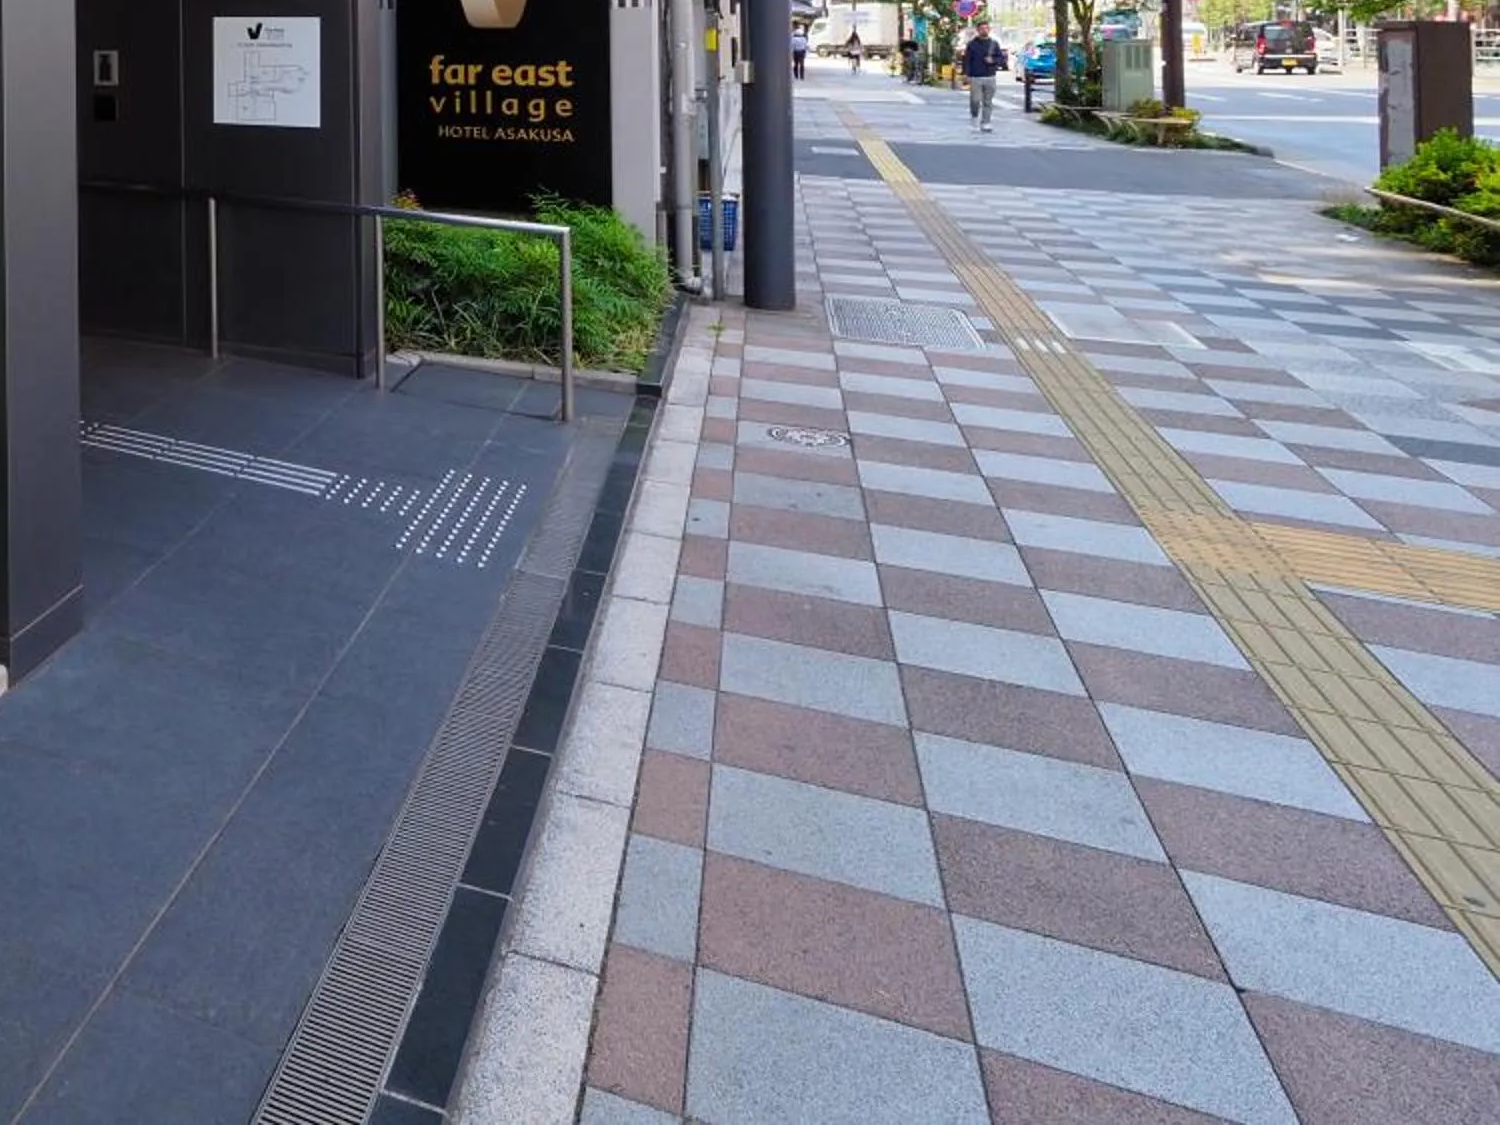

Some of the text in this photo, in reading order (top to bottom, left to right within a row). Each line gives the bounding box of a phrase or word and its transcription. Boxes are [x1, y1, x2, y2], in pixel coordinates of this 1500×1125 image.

[430, 56, 573, 86] far east
[430, 91, 573, 121] village
[439, 125, 575, 142] HOTEL ASAKUSA
